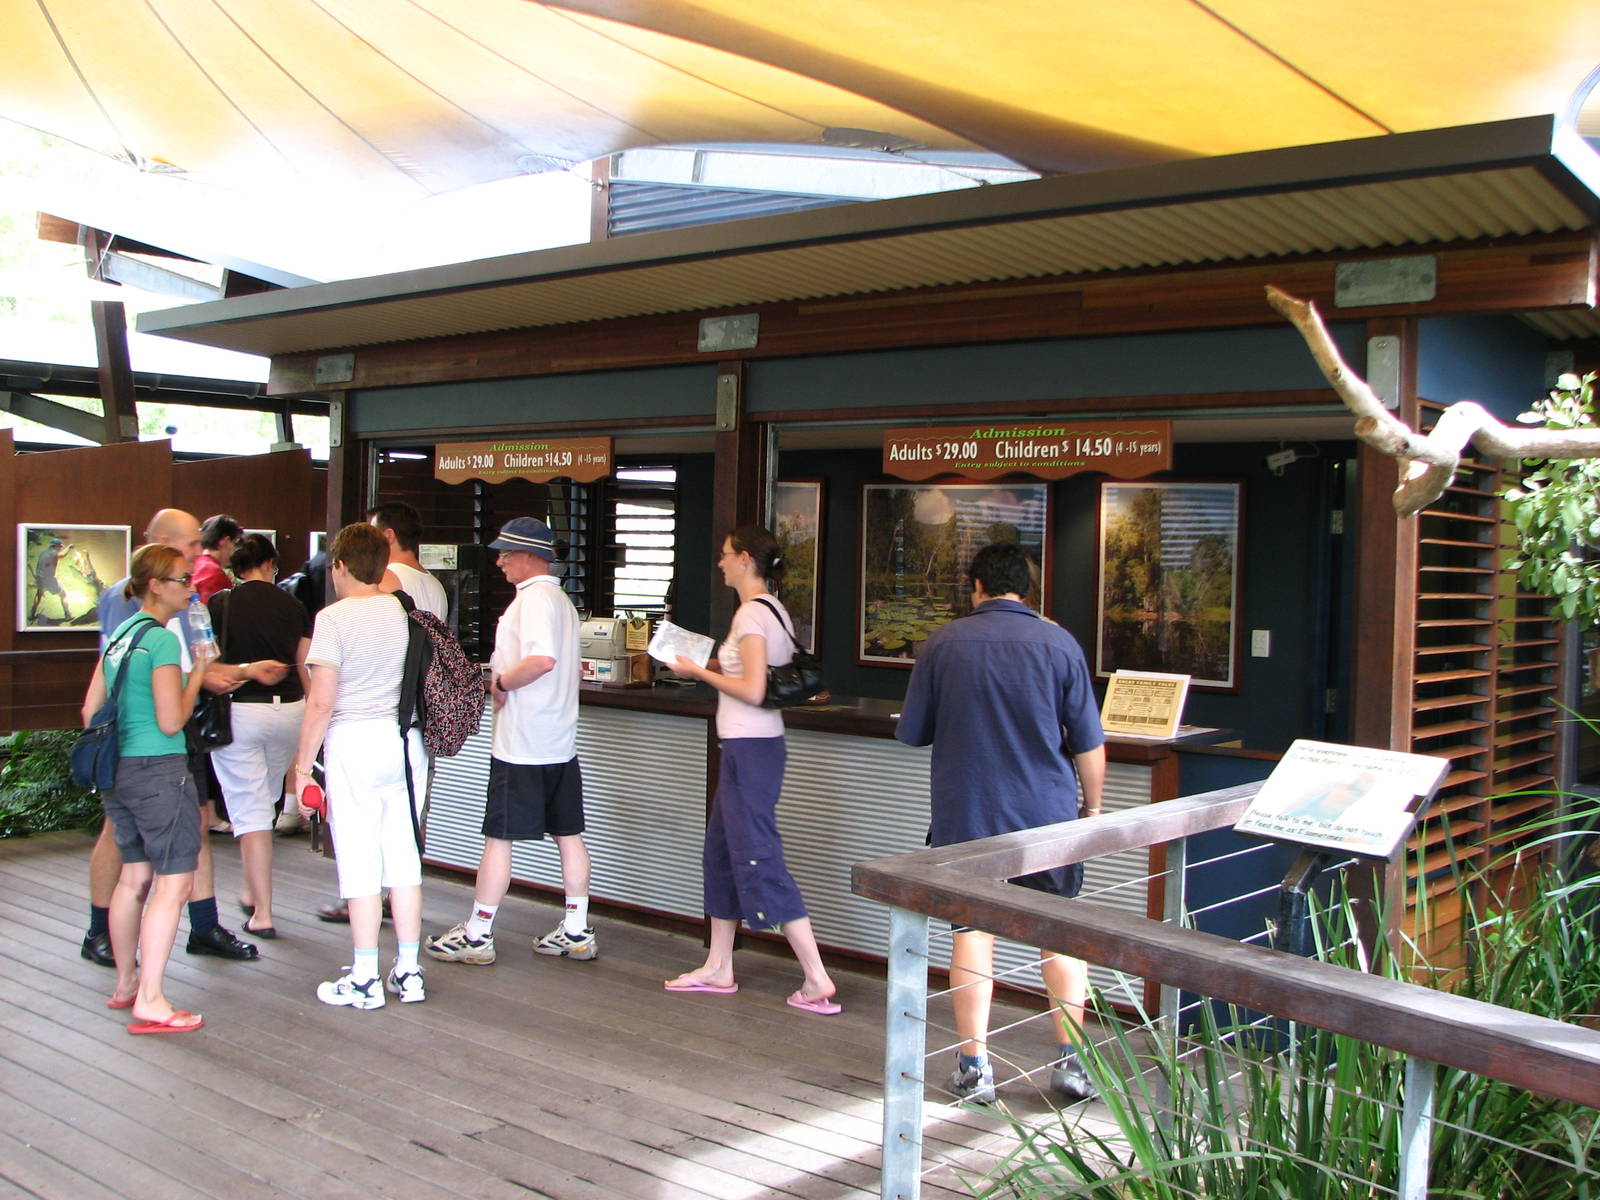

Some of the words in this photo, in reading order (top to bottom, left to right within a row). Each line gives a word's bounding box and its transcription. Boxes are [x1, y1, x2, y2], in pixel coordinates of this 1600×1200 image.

[969, 426, 1066, 439] Admission
[488, 442, 550, 452] Admission
[889, 443, 933, 461] Adults
[995, 440, 1059, 459] Children
[1139, 441, 1162, 457] years)
[438, 456, 467, 470] Adults
[504, 452, 544, 468] Children
[954, 461, 982, 469] Entry
[984, 460, 1018, 468] subject
